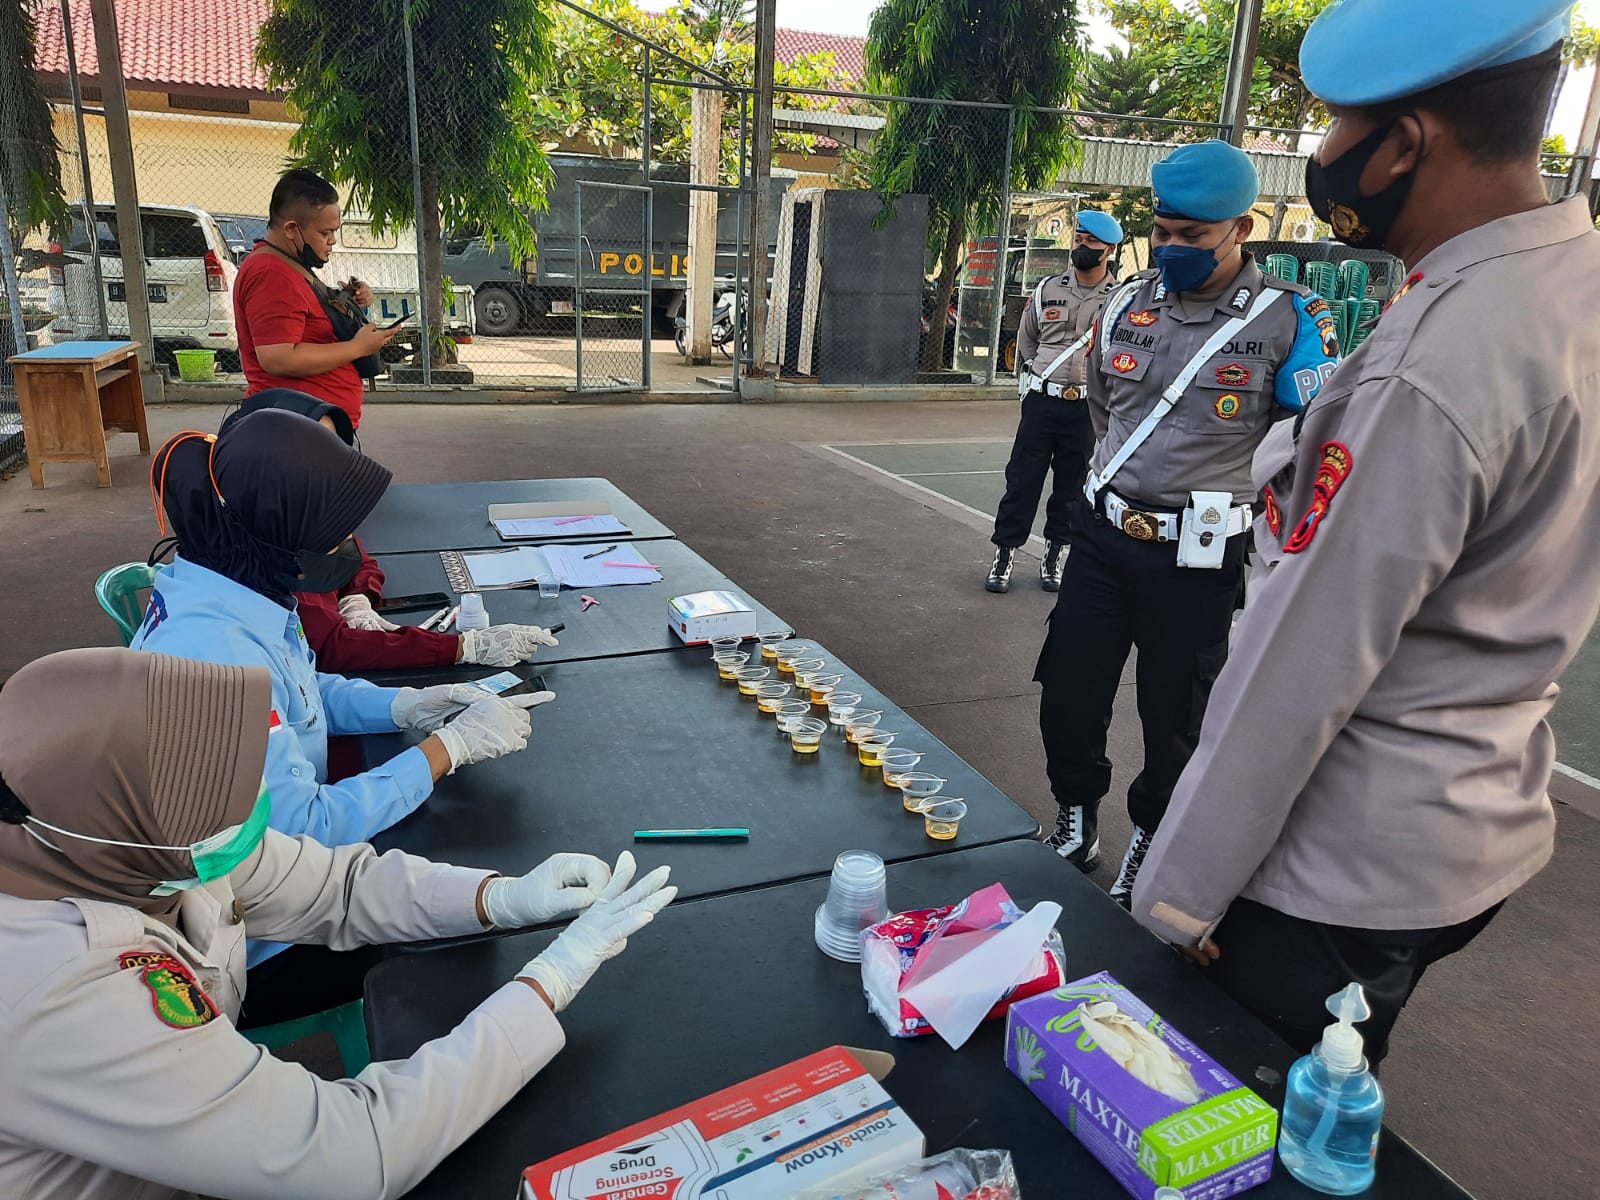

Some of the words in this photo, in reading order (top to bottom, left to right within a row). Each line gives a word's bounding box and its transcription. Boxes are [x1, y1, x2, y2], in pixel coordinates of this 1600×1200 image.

[1220, 341, 1263, 355] OLRI
[785, 1117, 897, 1174] Touch&Know
[1059, 1064, 1159, 1176] MAXTER
[1158, 1094, 1266, 1147] MAXTER
[595, 1166, 674, 1190] Screening
[609, 1155, 656, 1172] Drugs
[1174, 1123, 1270, 1181] MAXTER
